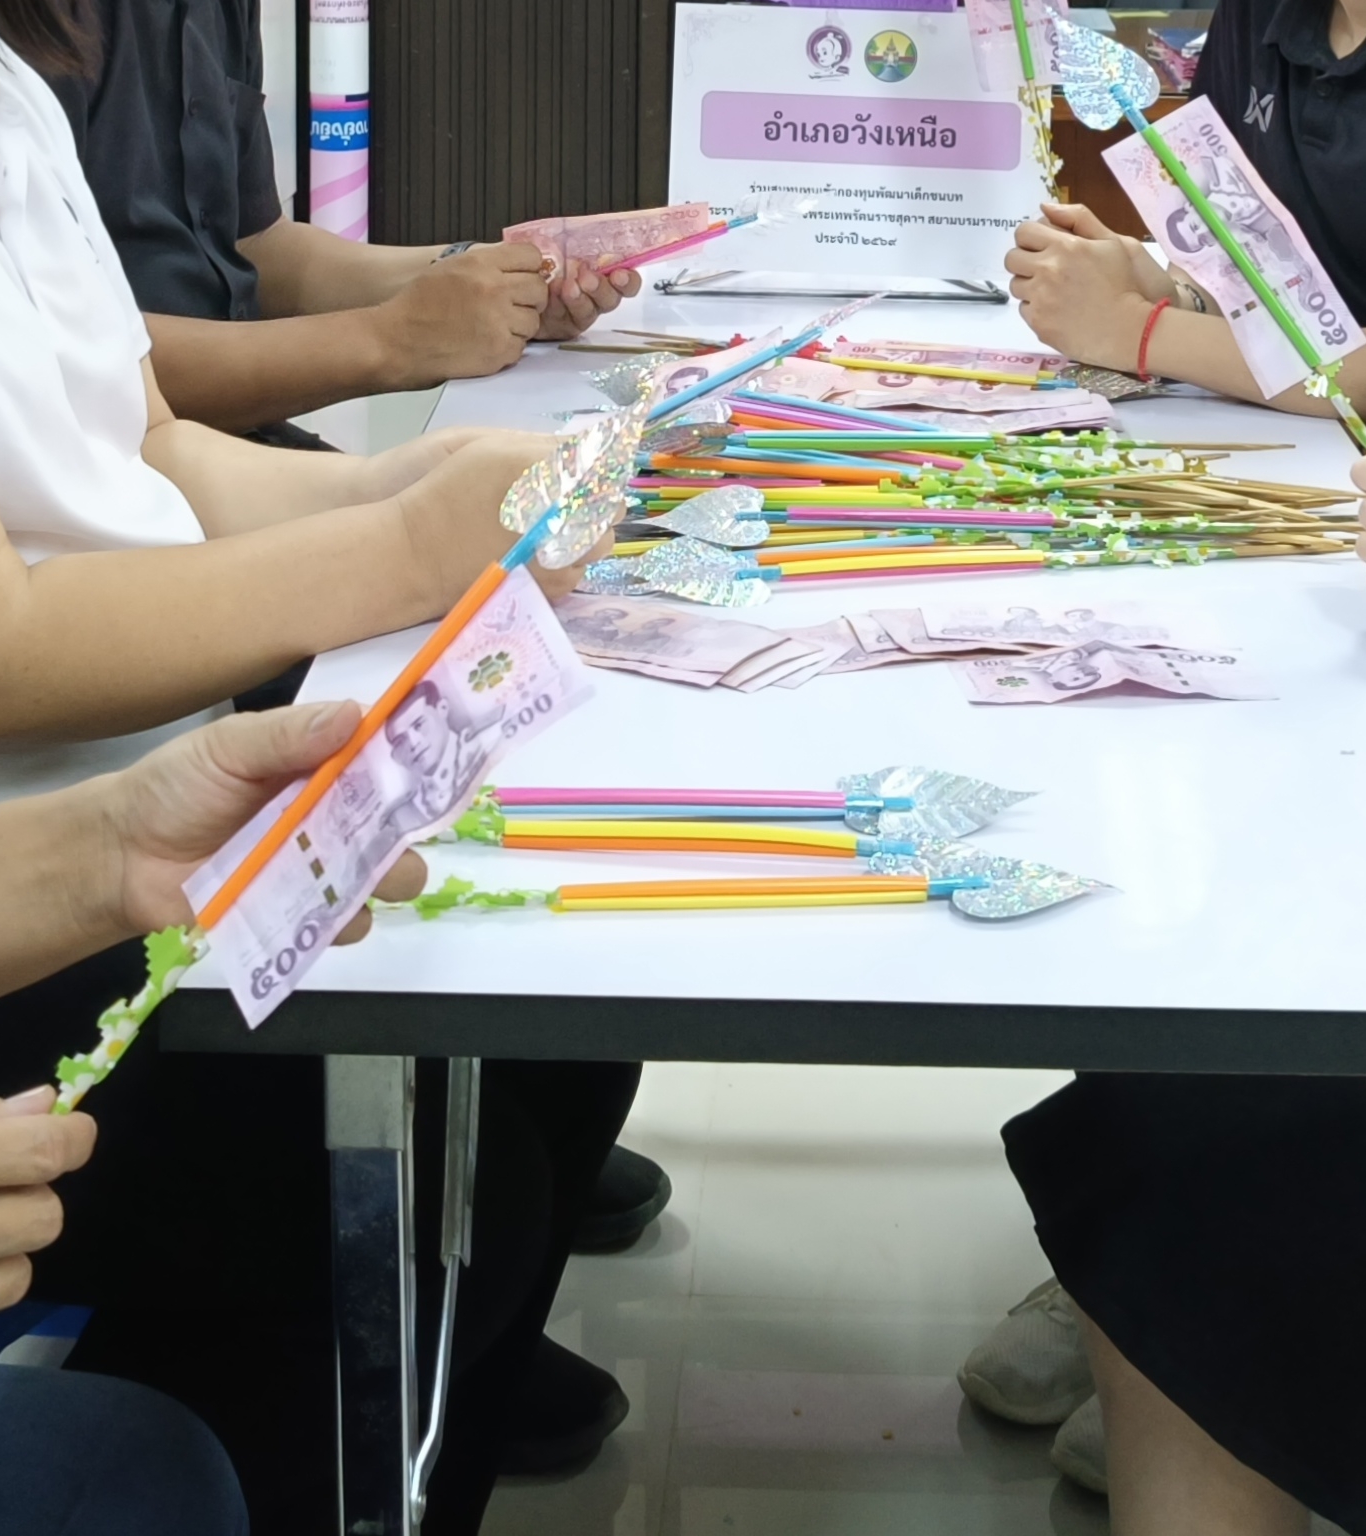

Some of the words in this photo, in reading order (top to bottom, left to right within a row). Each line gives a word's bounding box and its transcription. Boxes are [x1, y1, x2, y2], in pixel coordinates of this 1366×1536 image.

[763, 110, 957, 149] อำเภอวังเหนือ
[1199, 123, 1228, 157] 500
[815, 232, 858, 245] ประจำปี
[500, 692, 555, 741] 500
